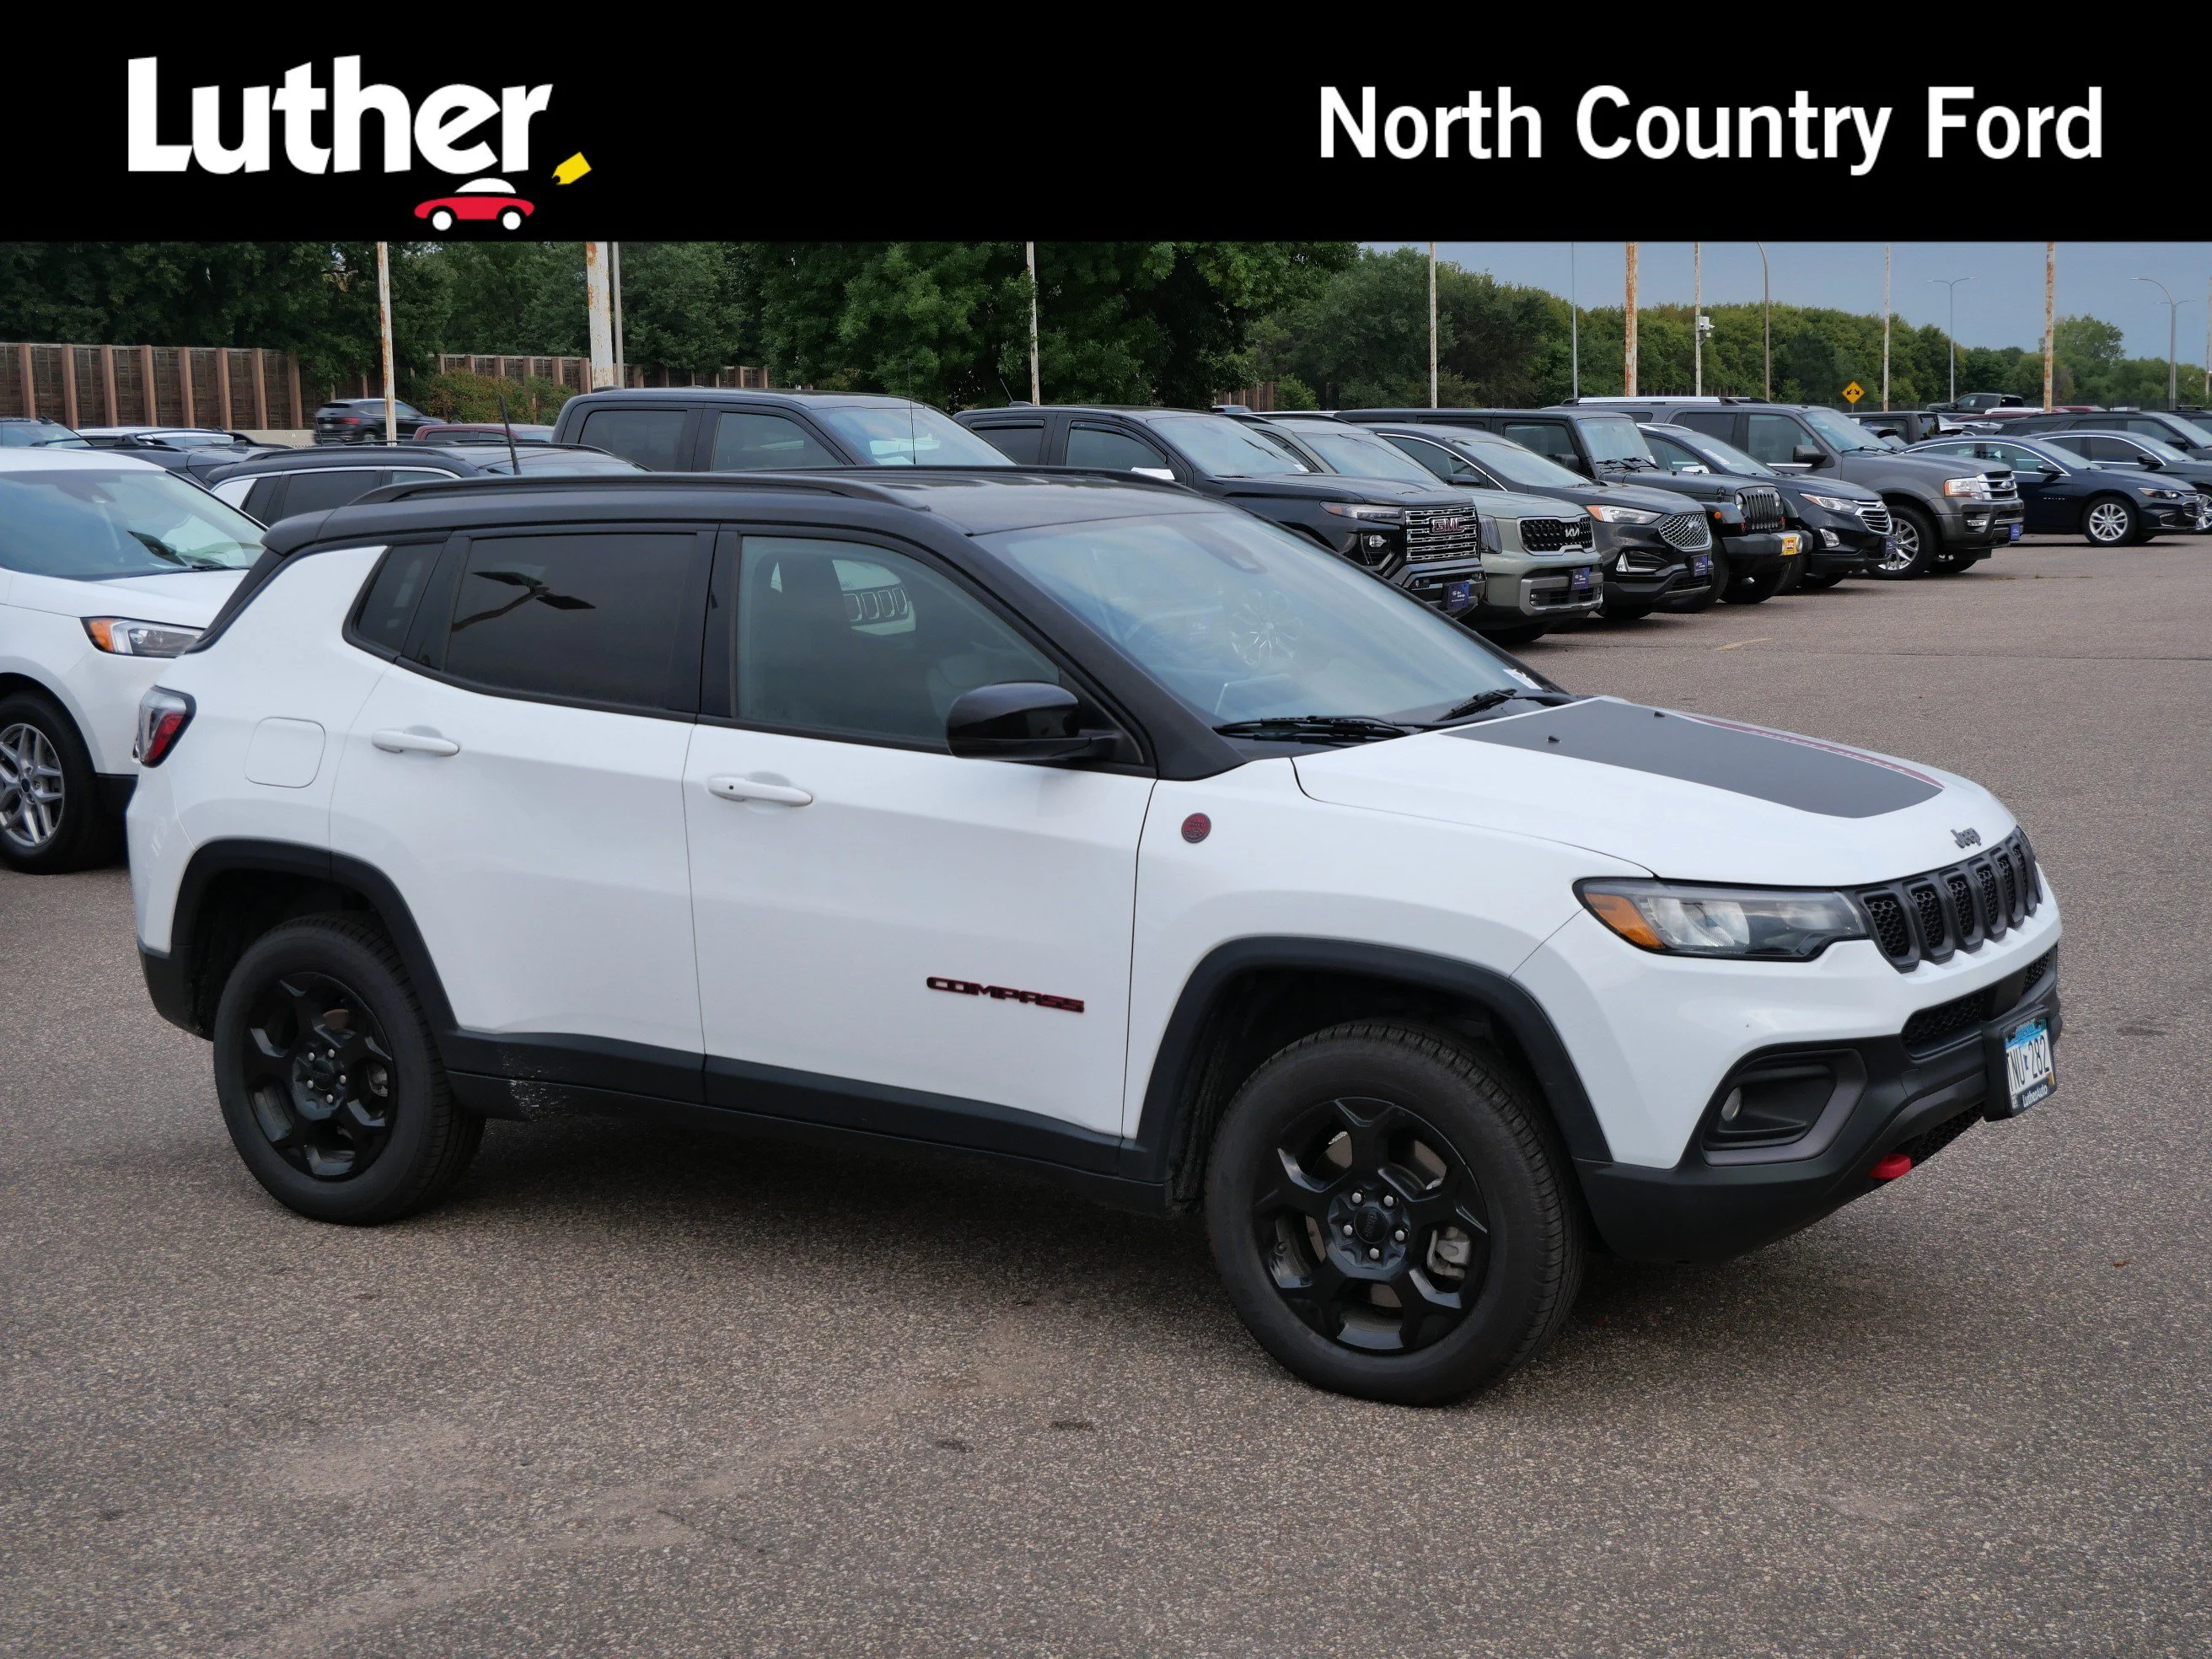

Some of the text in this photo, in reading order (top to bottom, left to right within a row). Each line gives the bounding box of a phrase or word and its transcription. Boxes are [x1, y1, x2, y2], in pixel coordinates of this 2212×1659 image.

[1432, 517, 1465, 533] GMC
[1951, 828, 1982, 849] Jeep
[926, 976, 1085, 1013] COMPASS
